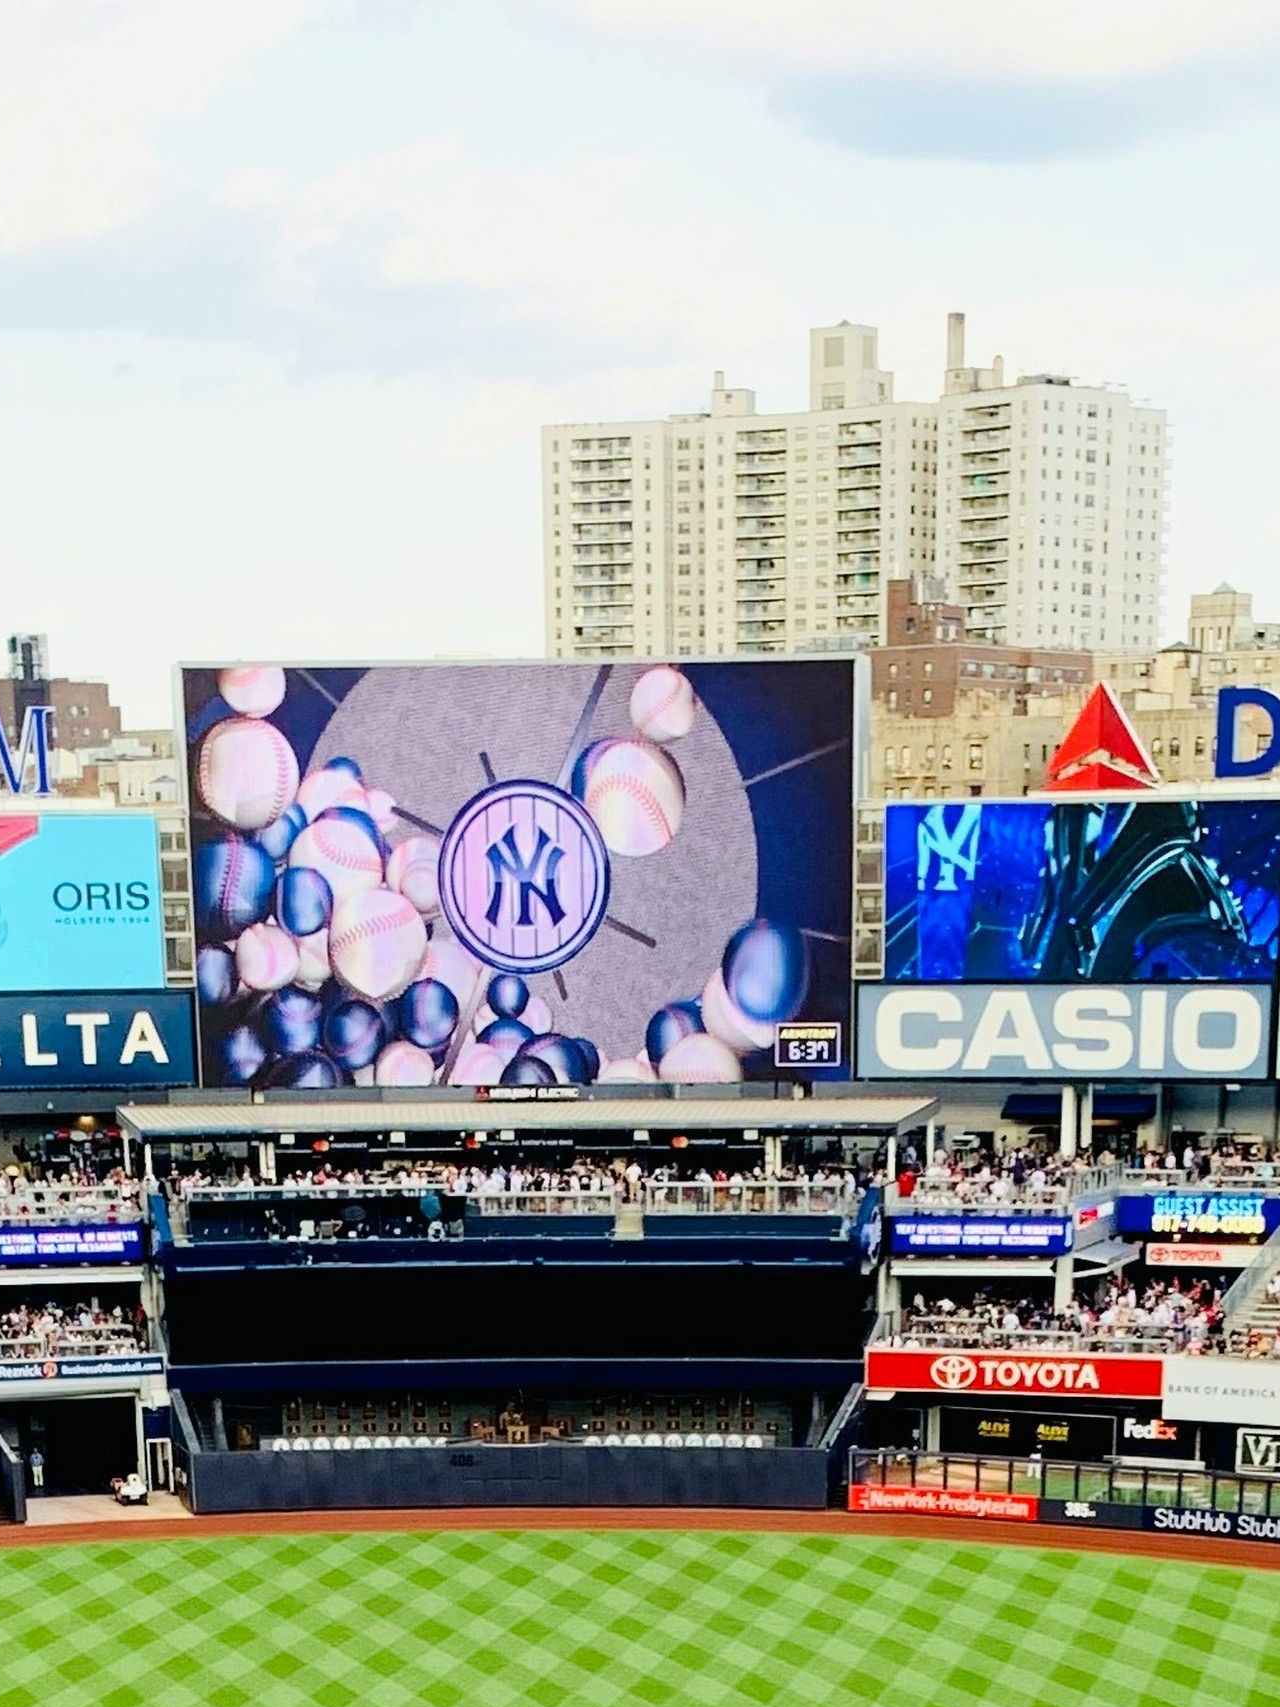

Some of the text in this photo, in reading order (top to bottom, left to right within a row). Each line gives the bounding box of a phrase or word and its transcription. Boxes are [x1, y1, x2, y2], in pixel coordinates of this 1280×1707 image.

[482, 823, 567, 928] NY
[52, 881, 151, 912] ORIS
[874, 988, 1265, 1072] CASIO
[788, 1041, 829, 1060] 6:37
[1153, 1197, 1266, 1216] GUEST ASSIST
[1170, 1249, 1222, 1263] TOYOTA
[979, 1359, 1101, 1391] TOYOTA
[1167, 1383, 1276, 1399] BANK OF AMERICA
[1123, 1418, 1177, 1441] FedEx
[1154, 1507, 1231, 1535] StubHub
